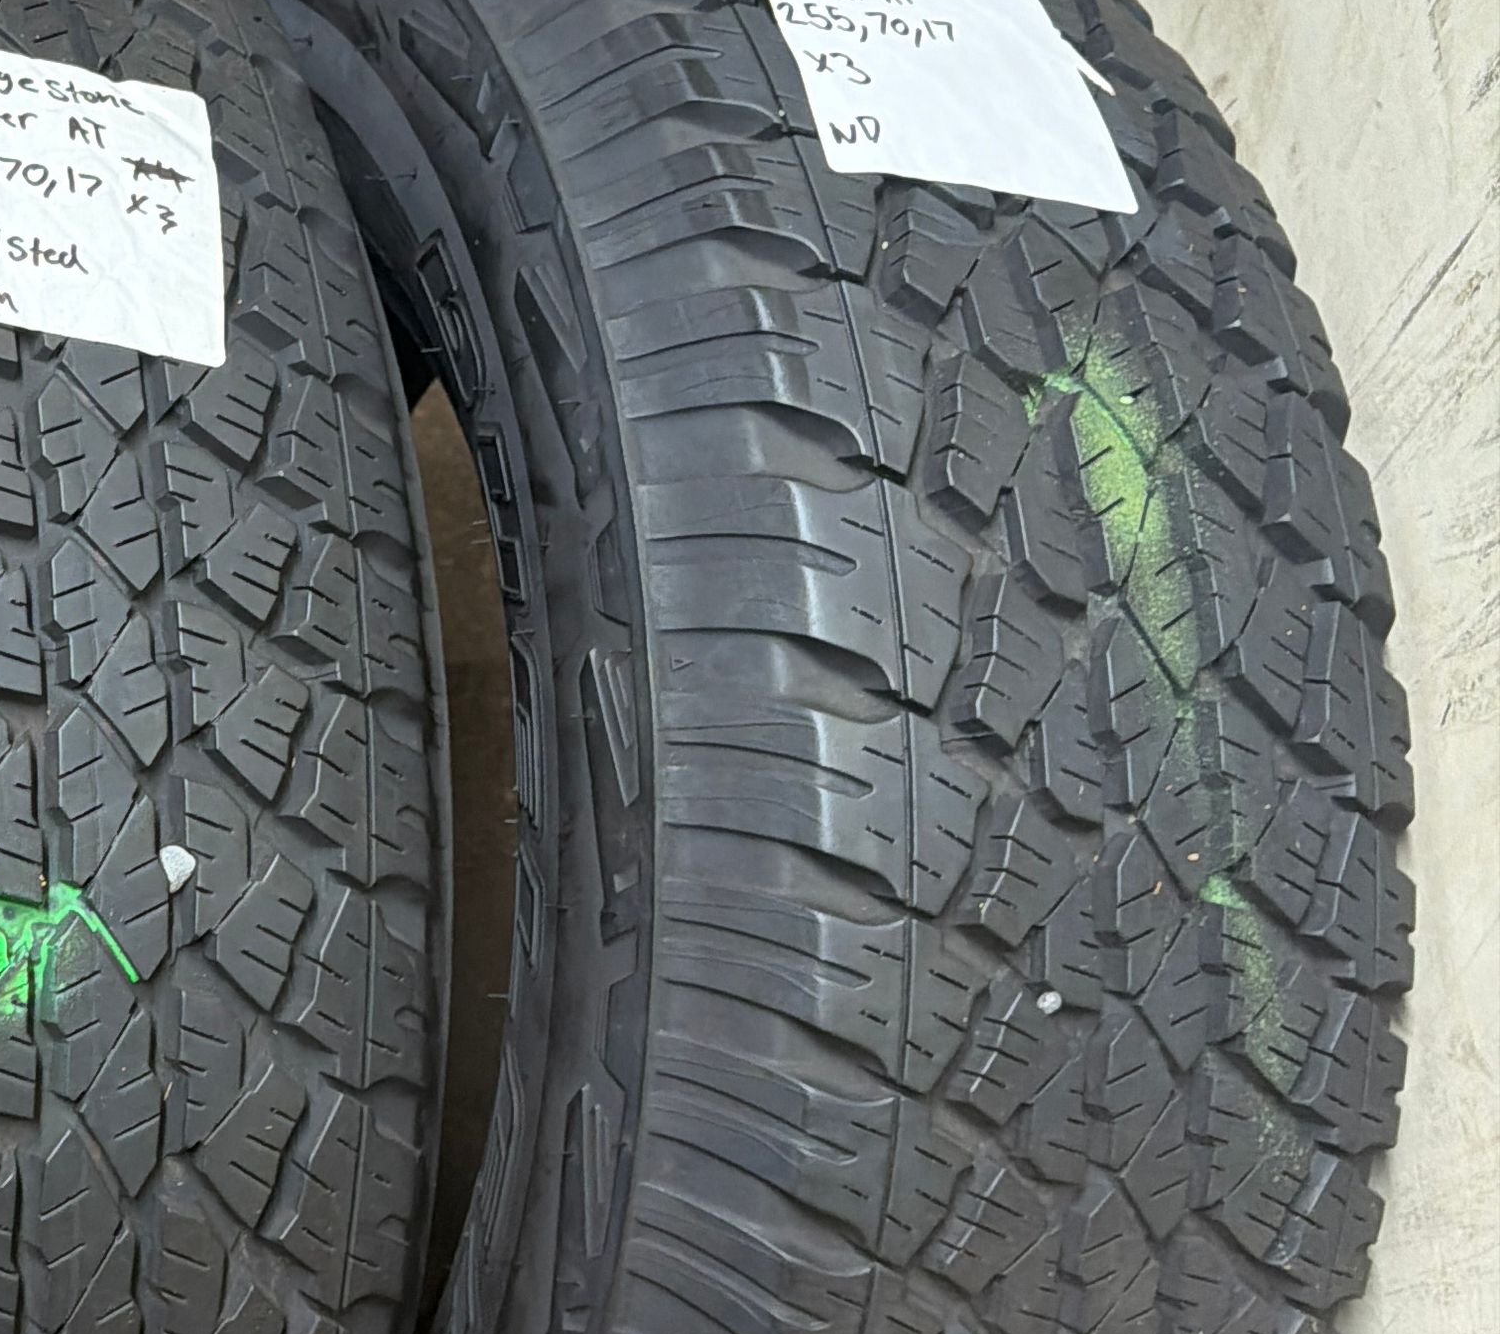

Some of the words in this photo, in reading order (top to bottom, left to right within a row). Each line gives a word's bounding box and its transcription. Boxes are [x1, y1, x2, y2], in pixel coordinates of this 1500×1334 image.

[776, 0, 956, 48] 255,70,17
[69, 115, 107, 149] AT
[829, 115, 881, 145] ND
